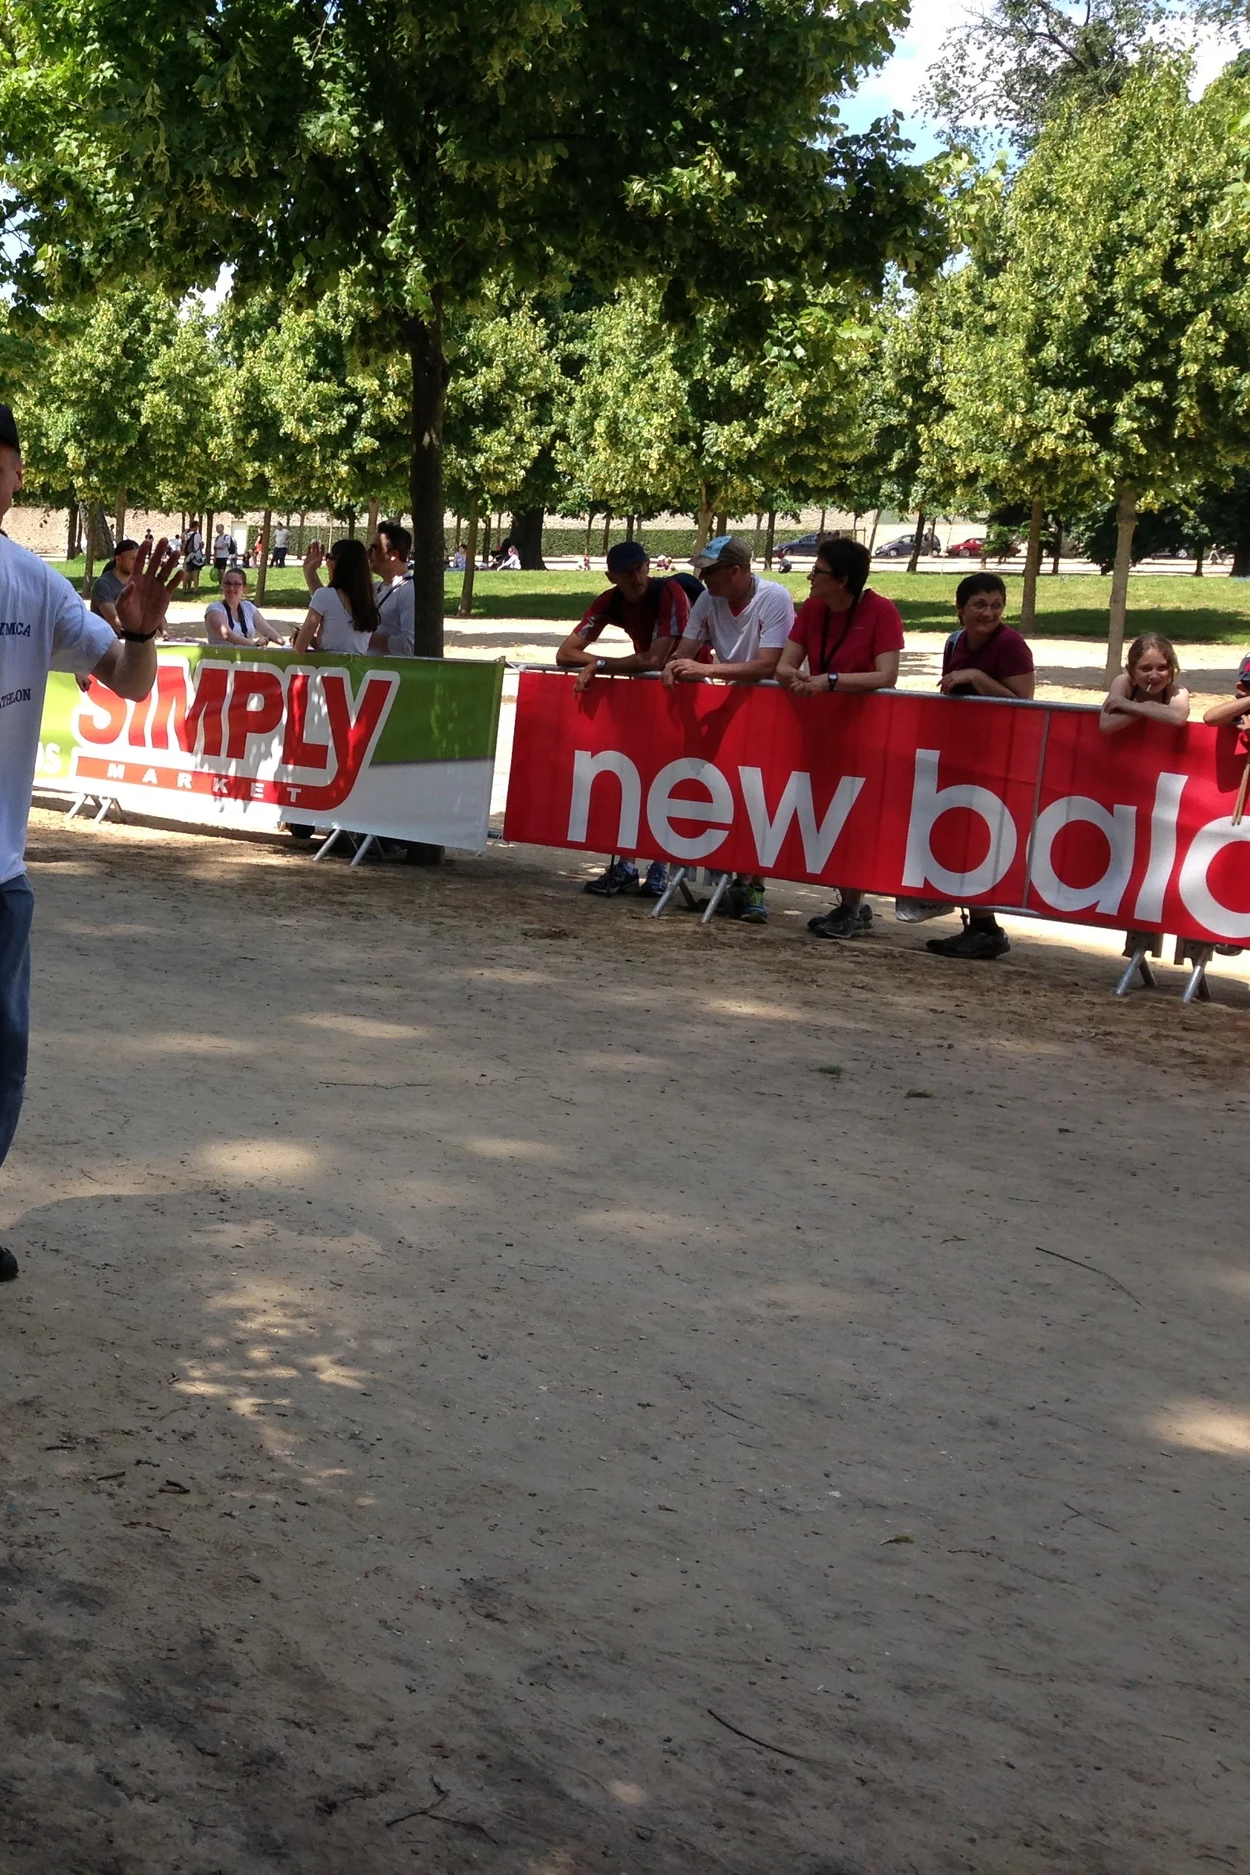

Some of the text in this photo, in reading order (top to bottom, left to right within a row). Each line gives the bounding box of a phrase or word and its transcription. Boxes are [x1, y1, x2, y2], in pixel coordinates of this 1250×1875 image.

[78, 665, 393, 811] SIMPLY
[107, 763, 301, 803] MARKET
[567, 750, 865, 874] new
